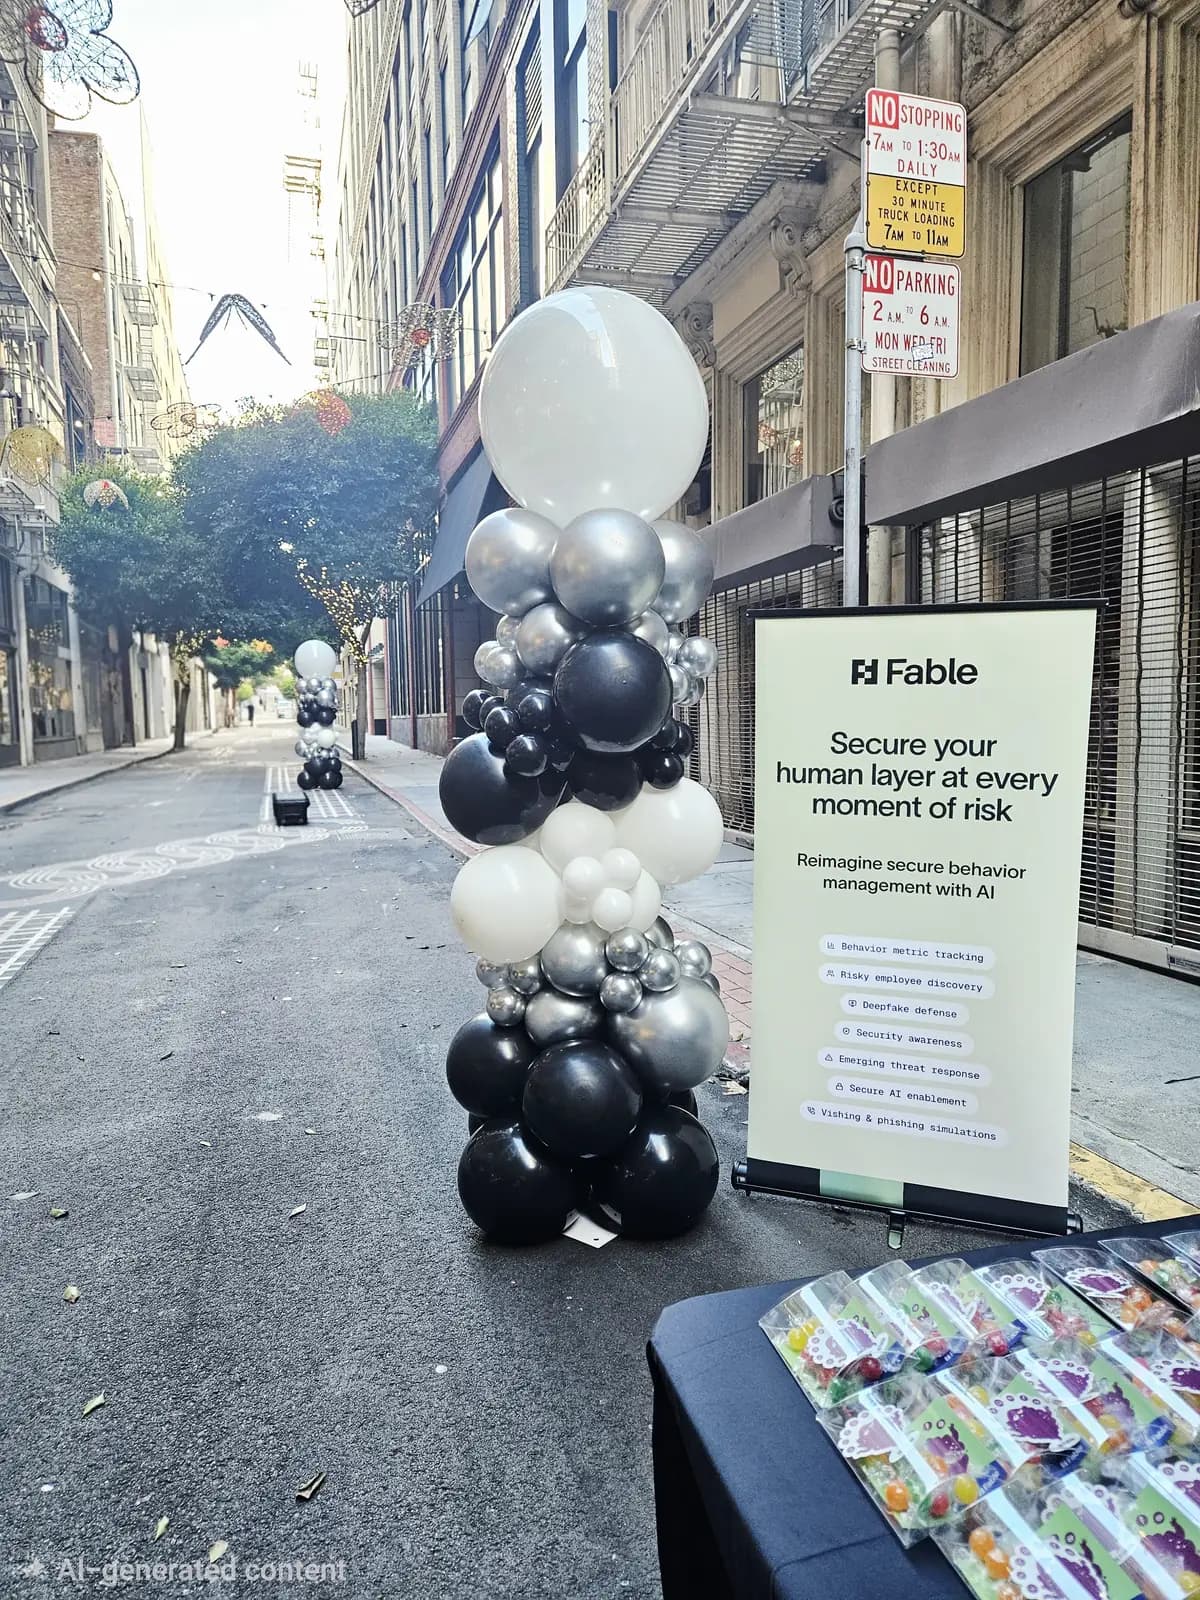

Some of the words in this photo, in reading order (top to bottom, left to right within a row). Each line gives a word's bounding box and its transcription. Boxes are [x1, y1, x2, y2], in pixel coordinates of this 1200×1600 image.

[871, 94, 896, 126] NO
[901, 105, 962, 132] STOPPING
[902, 140, 912, 151] TO
[897, 159, 938, 177] DAILY
[896, 180, 938, 196] EXCEPT
[892, 196, 904, 207] 30
[911, 198, 946, 212] MINUTE
[878, 208, 910, 222] TRUCK
[914, 213, 955, 228] LOADING
[912, 231, 921, 241] TO
[866, 259, 892, 291] NO
[897, 270, 955, 296] PARKING
[873, 300, 883, 322] 2
[887, 312, 905, 324] A.M.
[906, 305, 914, 315] TO
[920, 304, 930, 325] 6
[934, 316, 950, 328] A.M.
[875, 331, 899, 350] MON
[930, 336, 947, 355] FRI
[872, 356, 904, 370] STREET
[907, 359, 951, 373] CLEANING
[887, 658, 978, 685] Fable
[830, 732, 926, 755] Secure
[934, 737, 997, 761] your
[776, 762, 863, 785] human
[871, 764, 934, 791] layer
[942, 767, 968, 788] at
[976, 770, 1058, 796] every
[812, 797, 922, 817] moment
[929, 797, 956, 819] of
[964, 798, 1013, 822] risk
[797, 853, 883, 871] Reimagine
[887, 859, 944, 874] secure
[949, 861, 1026, 879] behavior
[823, 878, 931, 896] management
[936, 882, 972, 898] with
[976, 885, 995, 899] AI
[841, 942, 887, 953] Behavior
[893, 946, 928, 957] metric
[935, 949, 984, 963] tracking
[841, 970, 869, 982] Risky
[875, 974, 922, 986] employee
[928, 978, 983, 993] discovery
[863, 1001, 909, 1013] Deepfake
[915, 1006, 957, 1019] defense
[856, 1029, 902, 1042] Security
[908, 1035, 962, 1049] awareness
[839, 1055, 885, 1068] Emerging
[891, 1061, 925, 1072] threat
[932, 1067, 980, 1080] response
[850, 1085, 884, 1096] Secure
[889, 1089, 901, 1098] AI
[907, 1091, 966, 1107] enablement
[821, 1109, 861, 1122] Vishing
[877, 1115, 924, 1131] phishing
[930, 1123, 996, 1141] simulations
